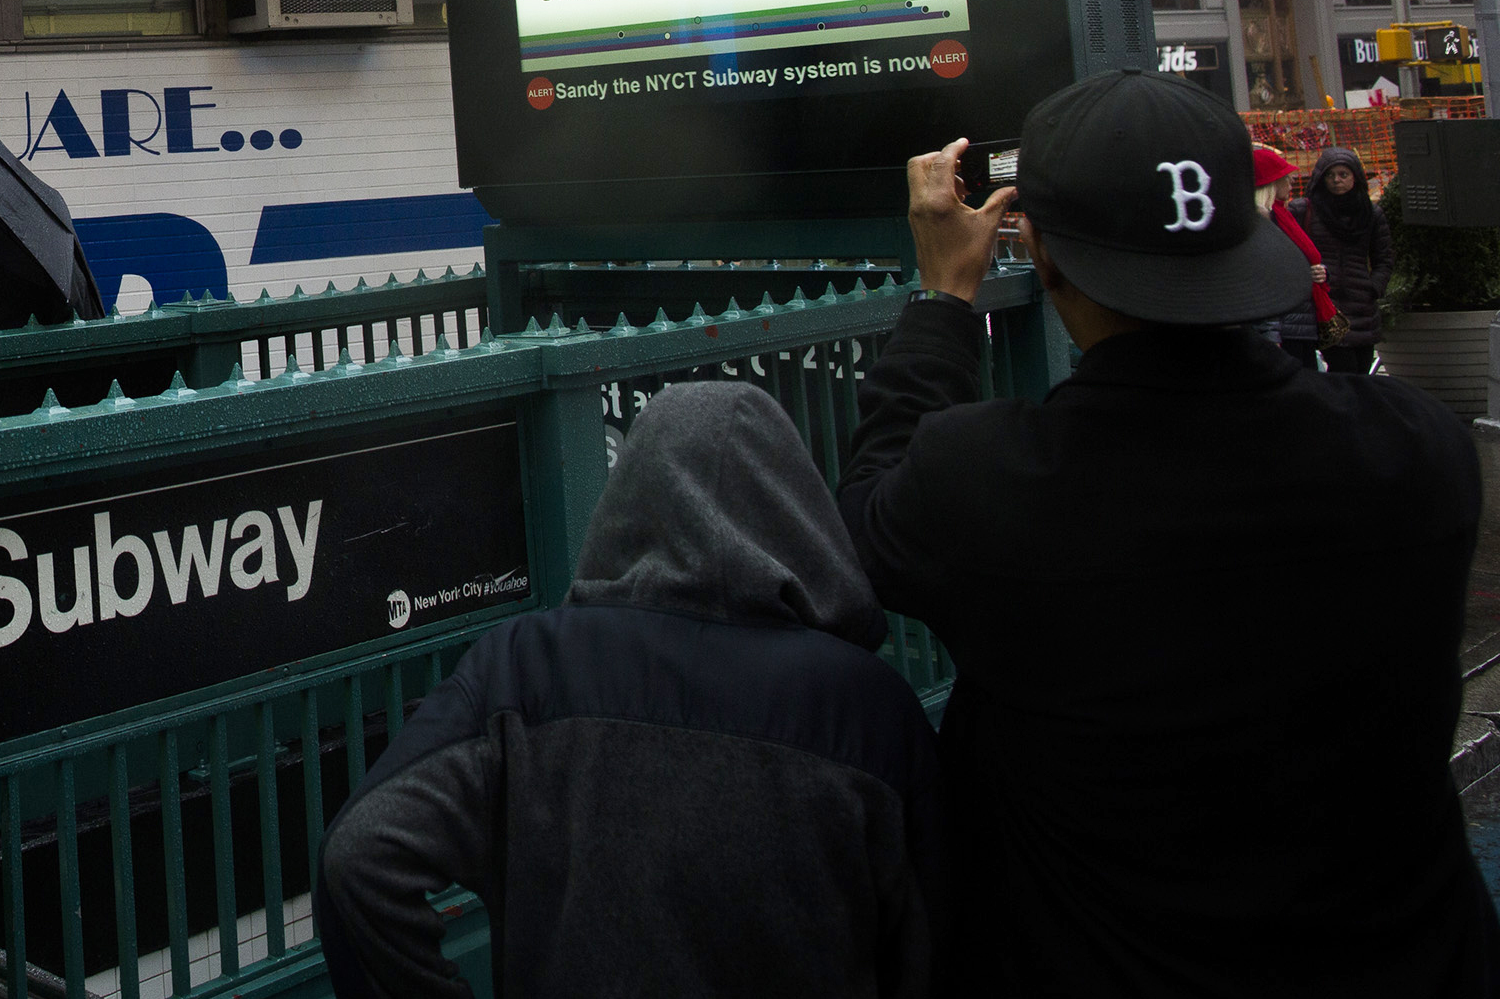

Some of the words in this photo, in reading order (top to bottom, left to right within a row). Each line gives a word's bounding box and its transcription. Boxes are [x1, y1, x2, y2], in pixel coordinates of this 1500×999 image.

[528, 87, 554, 99] ALERT
[555, 79, 608, 101] Sandy
[613, 77, 641, 95] the
[646, 71, 697, 92] NYCT
[702, 66, 778, 90] Subway
[784, 59, 857, 83] system
[863, 56, 882, 73] is
[888, 54, 932, 72] now
[932, 51, 967, 65] ALERT
[1156, 160, 1216, 232] B
[414, 594, 438, 611] New
[438, 587, 461, 603] York
[462, 581, 483, 598] City
